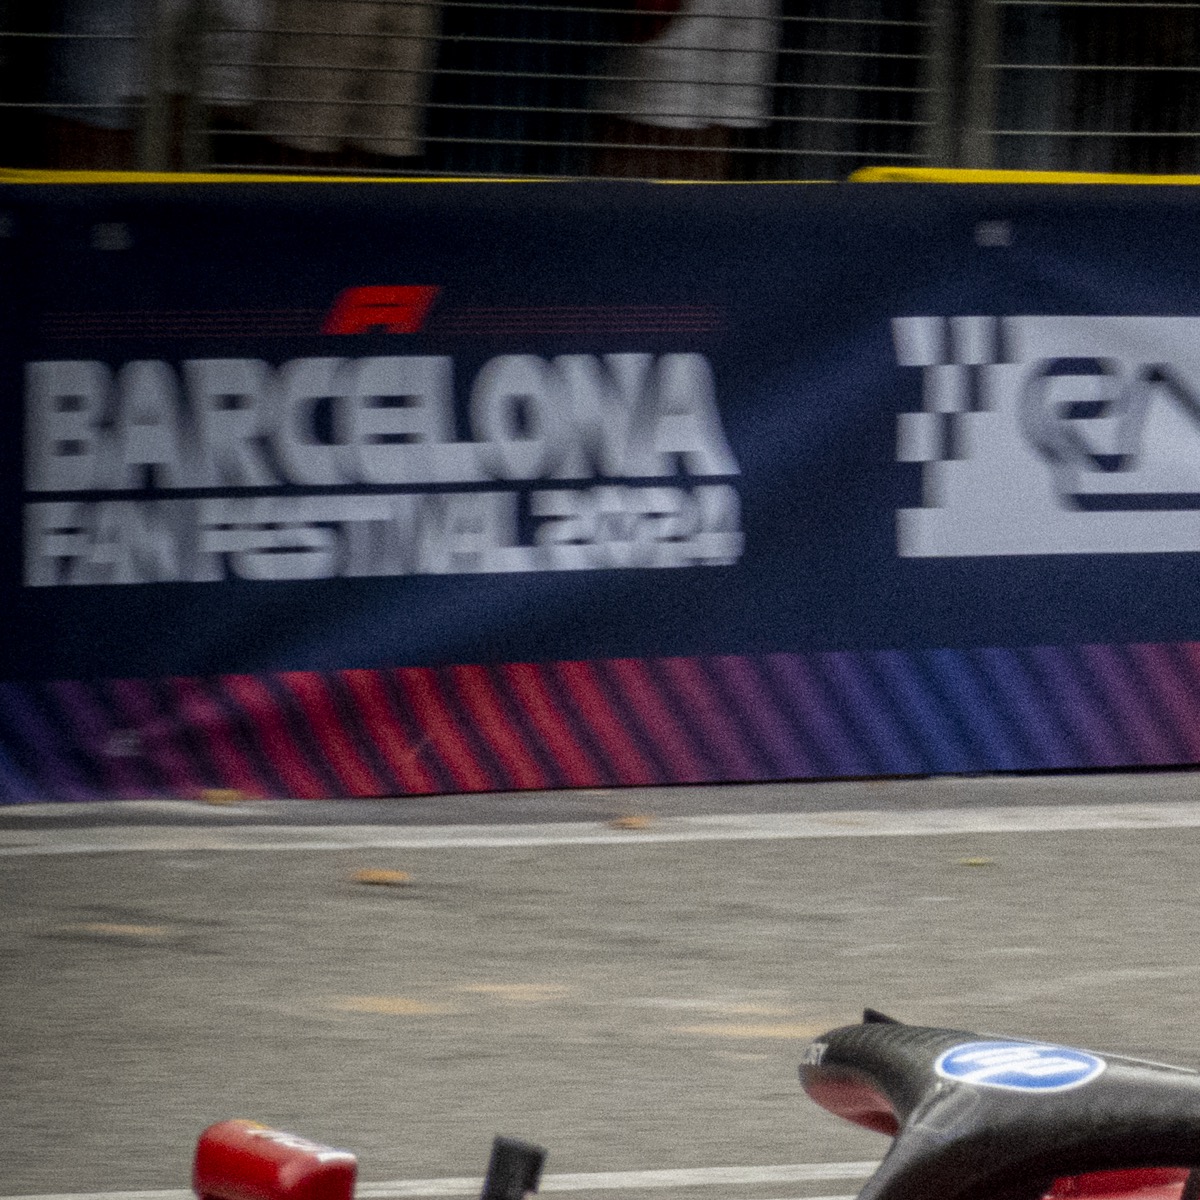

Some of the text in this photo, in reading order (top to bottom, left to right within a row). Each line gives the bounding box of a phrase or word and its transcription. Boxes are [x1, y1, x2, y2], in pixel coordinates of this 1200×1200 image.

[24, 353, 741, 491] BARCELONA
[22, 499, 190, 587] FAN
[196, 491, 535, 582] FESTIVAL
